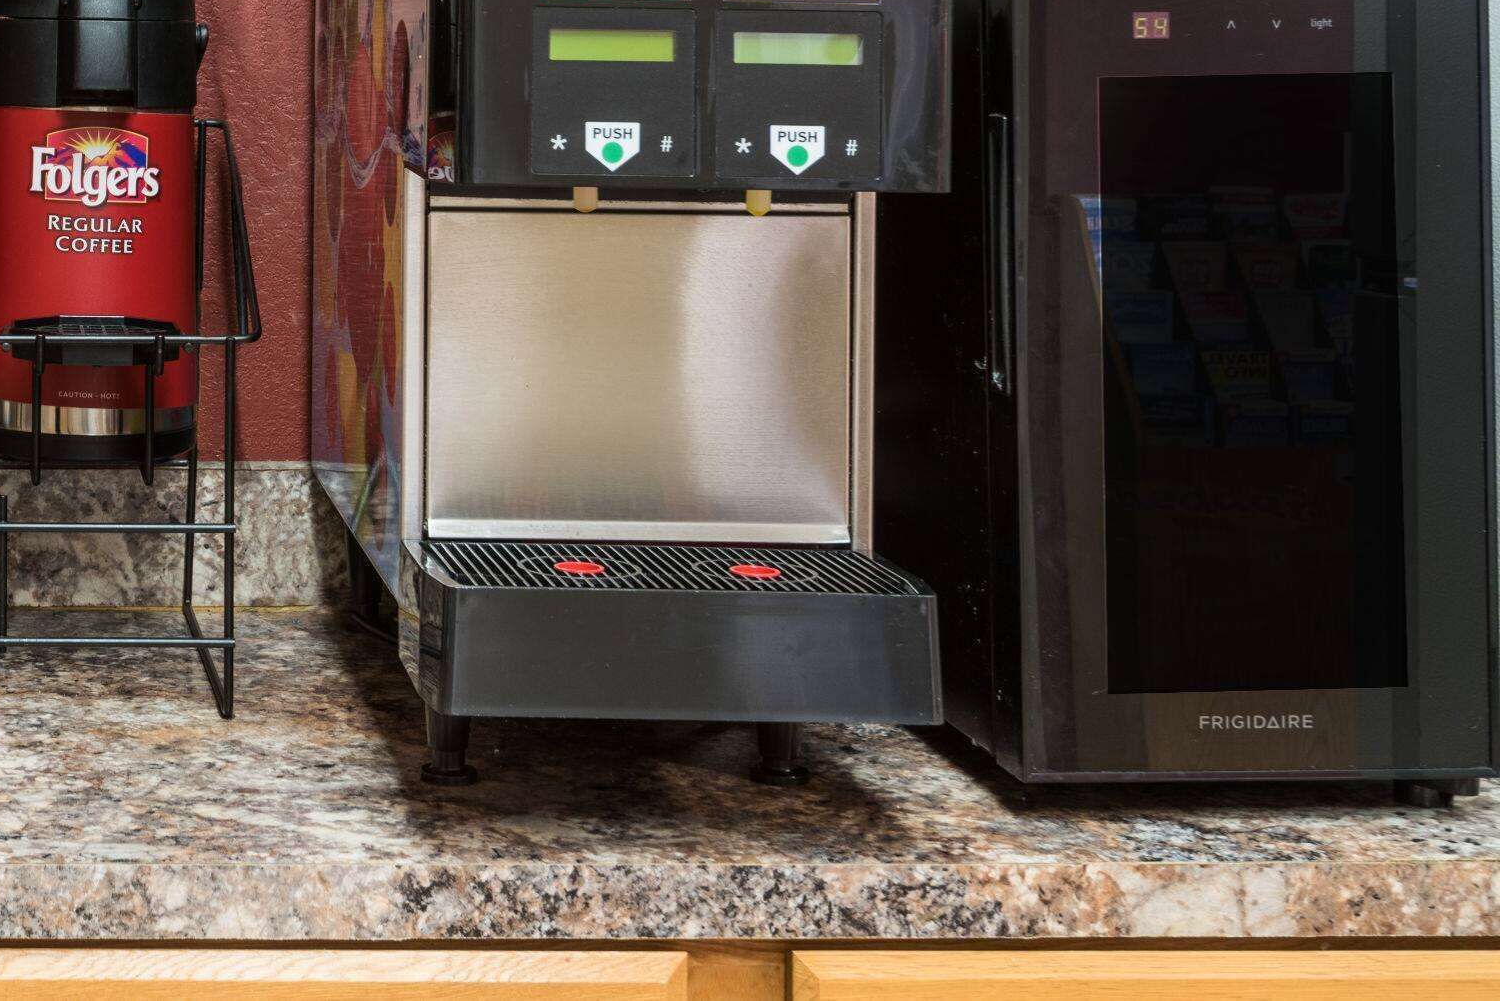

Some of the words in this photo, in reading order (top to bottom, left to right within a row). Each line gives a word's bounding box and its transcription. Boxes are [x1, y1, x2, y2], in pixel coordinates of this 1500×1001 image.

[1134, 17, 1169, 39] 54
[592, 128, 633, 140] PUSH
[777, 131, 818, 143] PUSH
[29, 145, 160, 207] Folgers
[47, 214, 143, 233] REGULAR
[55, 235, 133, 254] COFFEE
[58, 391, 93, 399] CAUTION
[1199, 714, 1314, 730] FRIGIDAIRE
